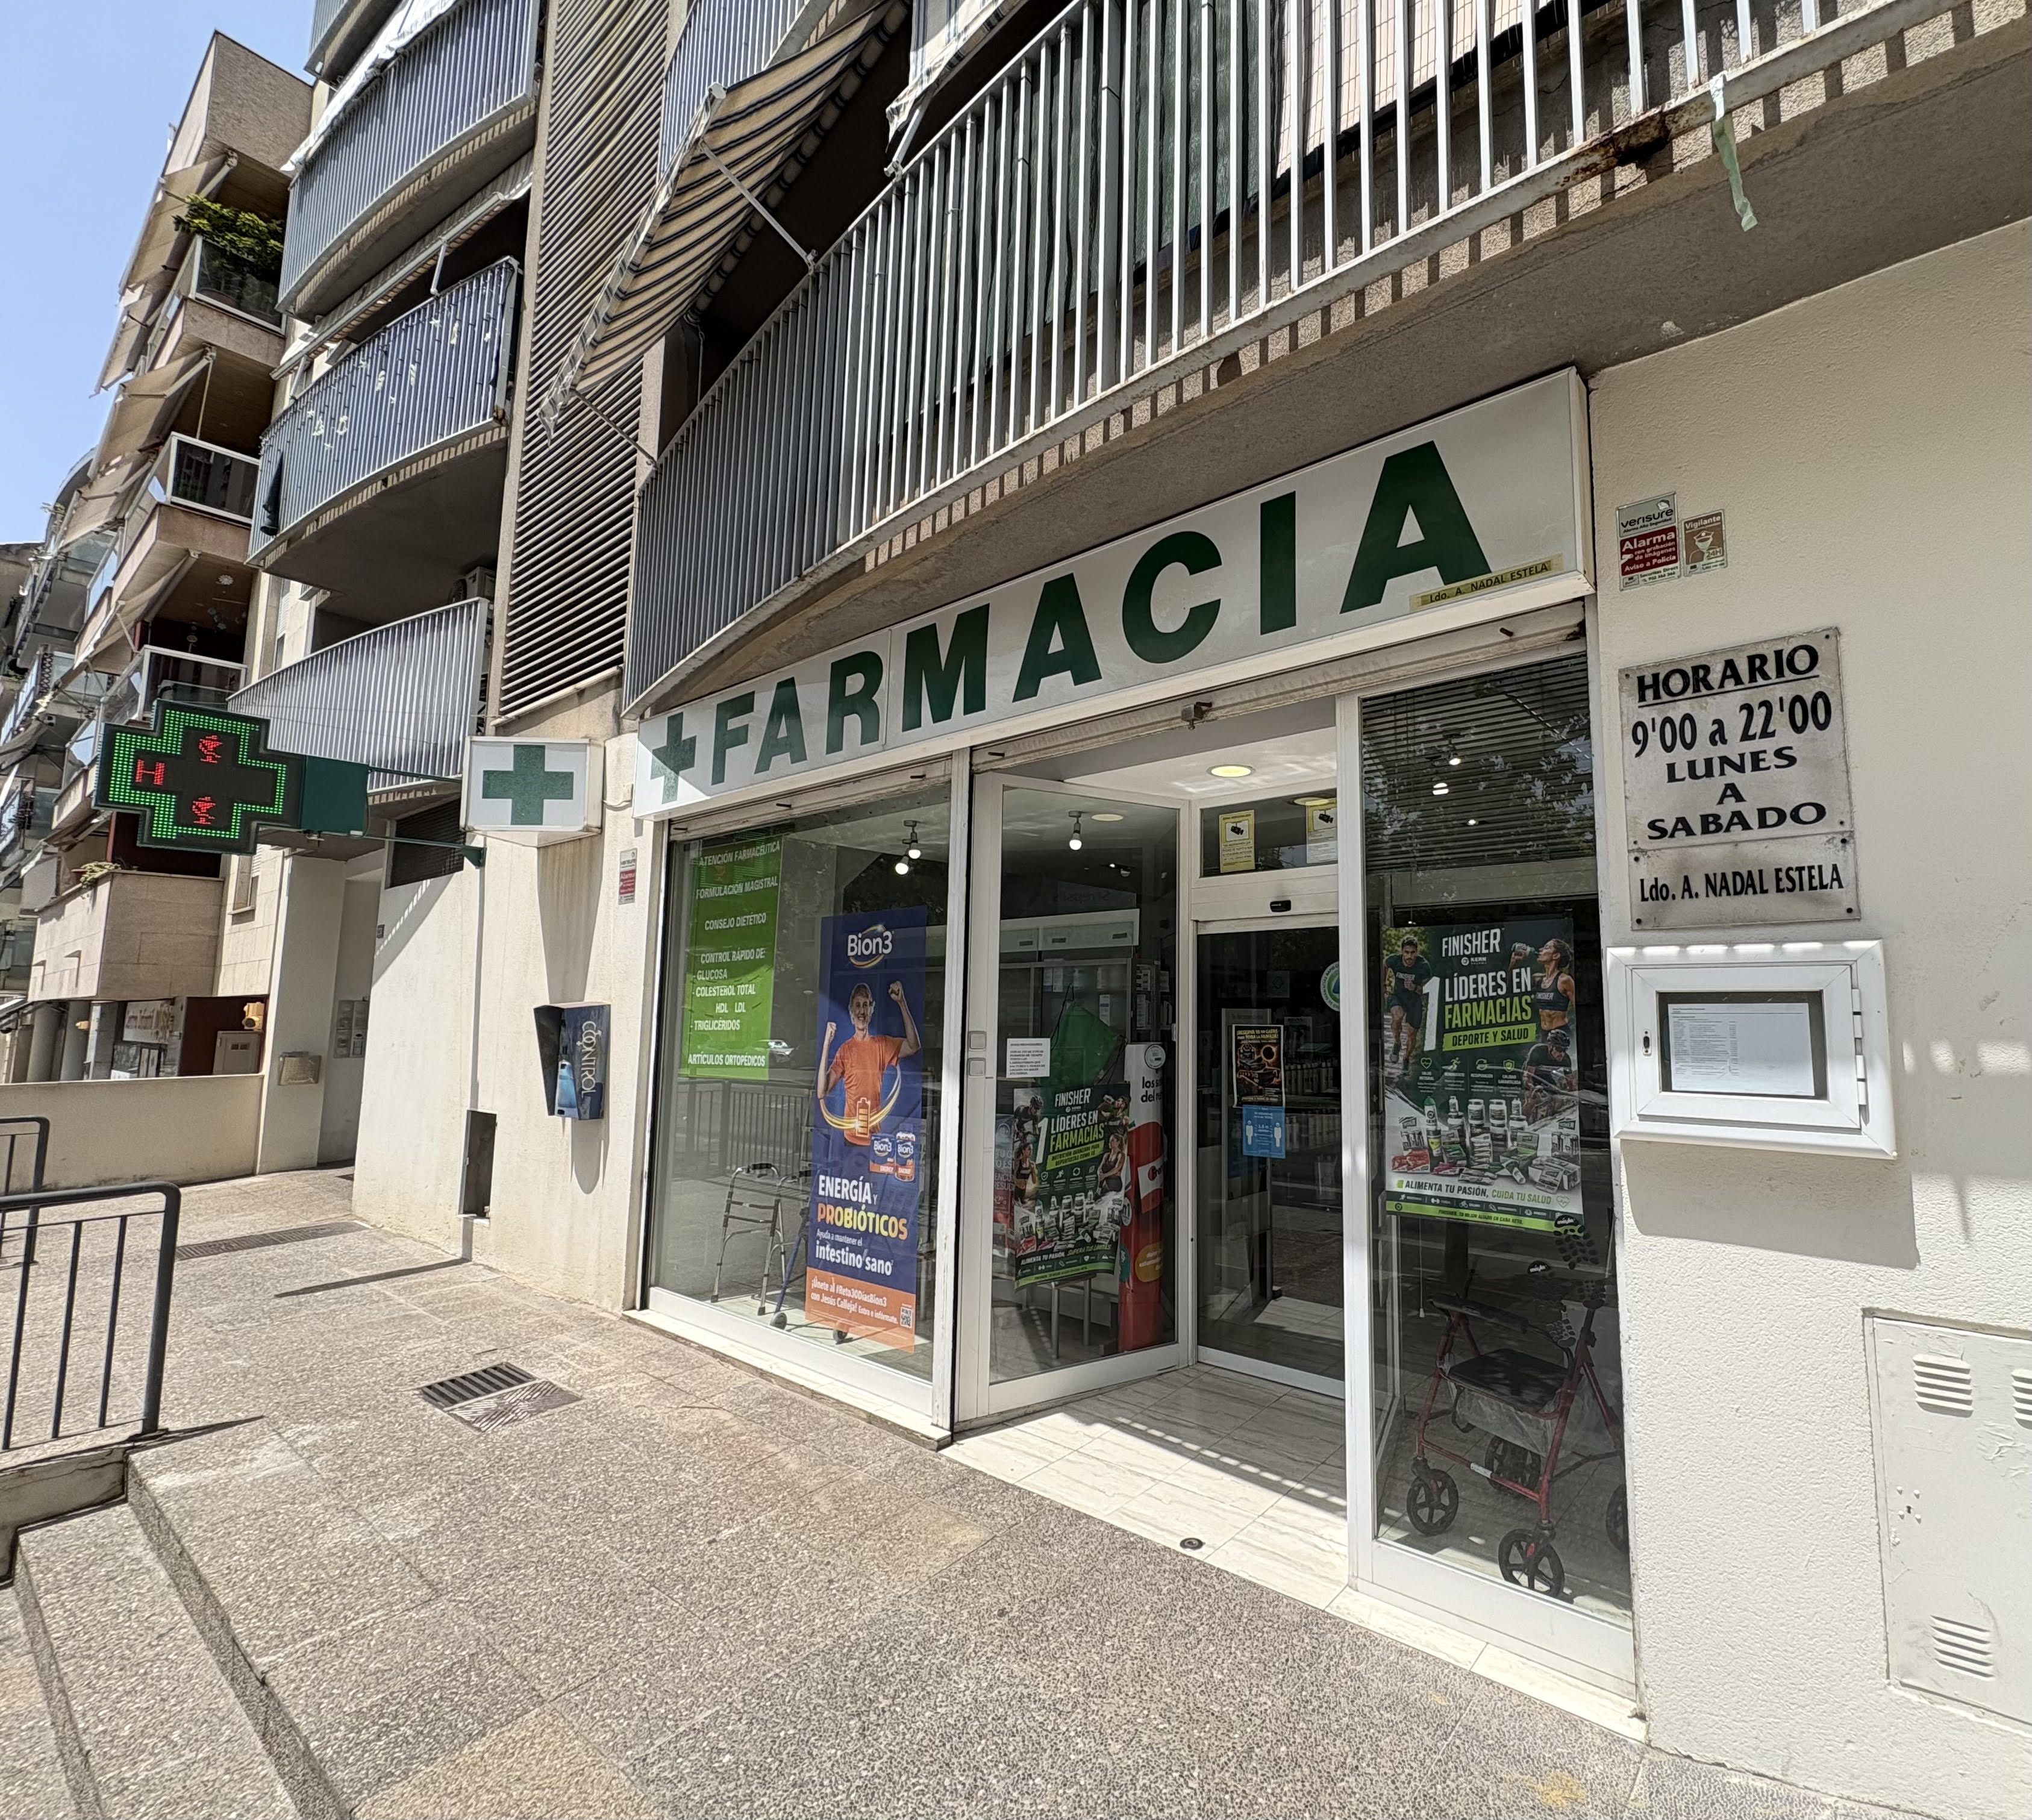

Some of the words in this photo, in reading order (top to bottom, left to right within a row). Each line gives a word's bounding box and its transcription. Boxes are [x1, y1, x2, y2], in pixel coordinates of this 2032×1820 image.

[1621, 508, 1674, 528] verisure
[1685, 515, 1721, 529] Vigilante
[1622, 531, 1675, 551] Alarma
[1645, 546, 1676, 558] imágenes
[1705, 548, 1722, 558] 24H
[1624, 563, 1644, 572] Aviso
[1652, 554, 1676, 565] Policía
[1430, 592, 1449, 603] Ldo.
[1455, 587, 1465, 596] A.
[1471, 577, 1506, 591] NADAL
[1510, 563, 1548, 581] ESTELA
[711, 440, 1492, 785] FARMACIA
[1637, 644, 1819, 703] HORARIO
[1631, 712, 1698, 758] 9'00
[1708, 718, 1728, 747] a
[1739, 690, 1832, 742] 22'00
[1666, 746, 1798, 783] LUNES
[1717, 783, 1747, 805] A
[1647, 802, 1827, 840] SABADO
[699, 850, 733, 866] ATENCIÓN
[696, 880, 743, 899] FORMULACIÓN
[744, 875, 778, 892] MAGISTRAL
[1640, 878, 1676, 902] Ldo.
[1681, 875, 1699, 899] A.
[1704, 869, 1769, 898] NADAL
[1774, 864, 1844, 894] ESTELA
[705, 917, 735, 930] CONSEJO
[736, 912, 766, 927] DIETÉTICO
[847, 931, 892, 957] Bion3
[1442, 928, 1501, 957] FINISHER
[701, 950, 731, 964] CONTROL
[732, 948, 754, 960] RÁPIDO
[697, 969, 727, 980] GLUCOSA
[1445, 971, 1506, 1002] LÍDERES
[1513, 967, 1531, 993] EN
[696, 986, 736, 997] COLESTEROL
[737, 984, 756, 995] TOTAL
[716, 1002, 728, 1013] HDL
[734, 1002, 746, 1013] LDL
[1422, 976, 1440, 1051] 1
[1445, 995, 1533, 1030] FARMACIAS
[694, 1017, 740, 1031] TRIGLICÉRIDOS
[1452, 1031, 1490, 1047] DEPORTE
[1492, 1030, 1498, 1043] Y
[1501, 1028, 1529, 1042] SALUD
[688, 1051, 724, 1065] ARTÍCULOS
[725, 1052, 766, 1066] ORTOPÉDICOS
[1142, 1076, 1154, 1089] los
[1054, 1088, 1091, 1107] FINISHER
[1140, 1089, 1155, 1103] del
[1051, 1112, 1087, 1134] LÍDERES
[1088, 1110, 1099, 1125] EN
[874, 1140, 892, 1152] Bion3
[1035, 1117, 1049, 1165] 1
[1049, 1122, 1105, 1152] FARMACIAS
[898, 1143, 914, 1154] Bion3
[873, 1193, 878, 1205] Y
[1405, 1181, 1443, 1192] ALIMENTA
[1445, 1184, 1454, 1193] TU
[1457, 1186, 1489, 1198] PASIÓN,
[1492, 1189, 1515, 1200] CUIDA
[1517, 1192, 1525, 1201] TU
[1527, 1193, 1551, 1204] SALUD
[817, 1202, 908, 1240] PROBIÓTICOS
[816, 1228, 831, 1240] Ayuda
[835, 1234, 857, 1245] mantener
[857, 1237, 863, 1246] el
[816, 1240, 863, 1269] intestino
[811, 1292, 821, 1301] con
[821, 1293, 836, 1306] Jesús
[837, 1297, 857, 1314] Calleja!
